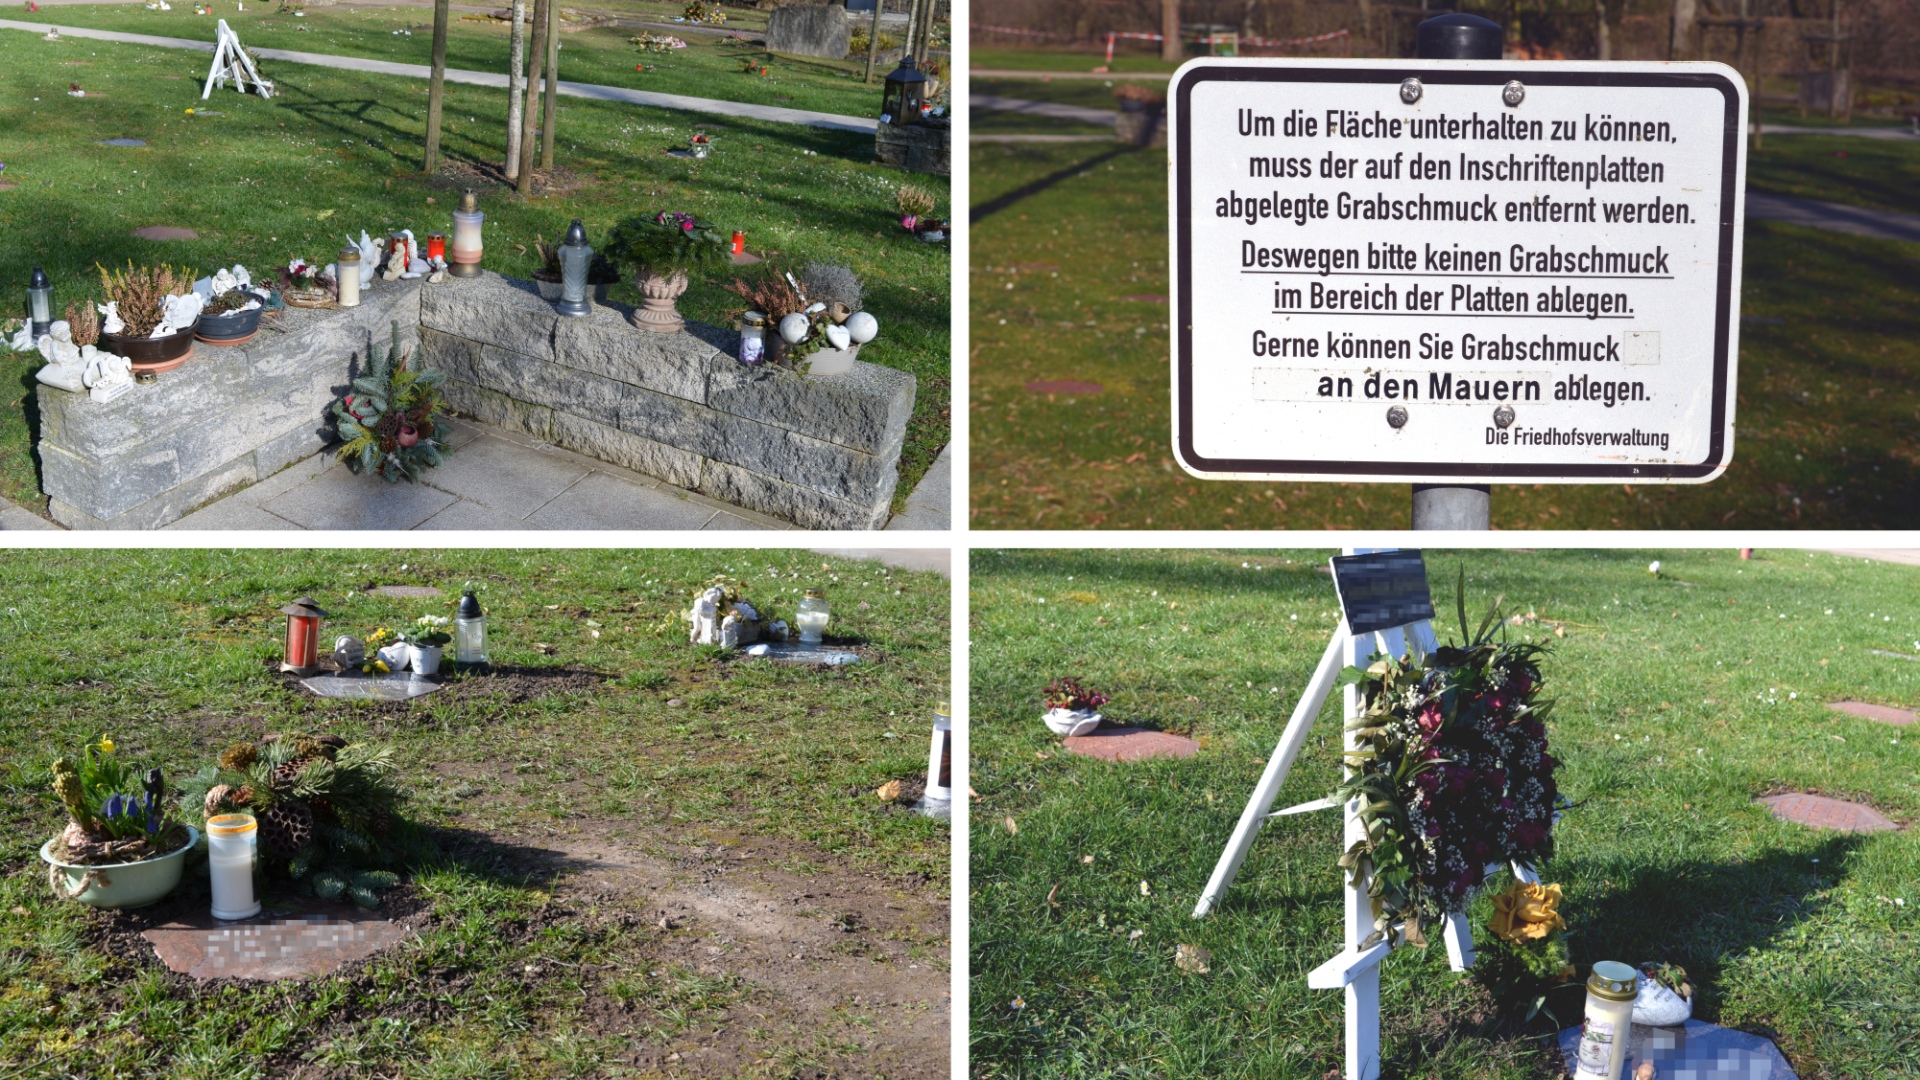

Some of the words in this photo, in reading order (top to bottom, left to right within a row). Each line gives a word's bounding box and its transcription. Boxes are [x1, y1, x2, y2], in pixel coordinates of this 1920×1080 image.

[1239, 109, 1274, 136] Um
[1284, 110, 1317, 137] die
[1327, 110, 1401, 138] Fläche
[1411, 112, 1542, 140] unterhalten
[1551, 121, 1576, 140] zu
[1585, 114, 1676, 143] können,
[1250, 157, 1311, 178] muss
[1320, 151, 1358, 178] der
[1366, 152, 1402, 179] auf
[1410, 153, 1450, 180] den
[1460, 153, 1663, 189] Inschriftenplatten
[1216, 190, 1328, 226] abgelegte
[1338, 192, 1497, 221] Grabschmuck
[1505, 195, 1596, 222] entfernt
[1603, 196, 1695, 223] werden.
[1241, 240, 1359, 275] Deswegen
[1368, 242, 1416, 270] bitte
[1426, 243, 1500, 271] keinen
[1510, 244, 1668, 273] Grabschmuck
[1275, 281, 1302, 309] im
[1311, 282, 1396, 310] Bereich
[1406, 284, 1443, 310] der
[1452, 284, 1528, 311] Platten
[1536, 286, 1634, 320] ablegen.
[1253, 330, 1318, 357] Gerne
[1328, 332, 1410, 359] können
[1419, 333, 1453, 359] Sie
[1462, 334, 1619, 361] Grabschmuck
[1318, 377, 1352, 397] an
[1364, 371, 1418, 399] den
[1430, 373, 1540, 400] Mauern
[1555, 374, 1650, 407] ablegen.
[1486, 426, 1509, 445] Die
[1514, 427, 1668, 450] Friedhofsverwaltung
